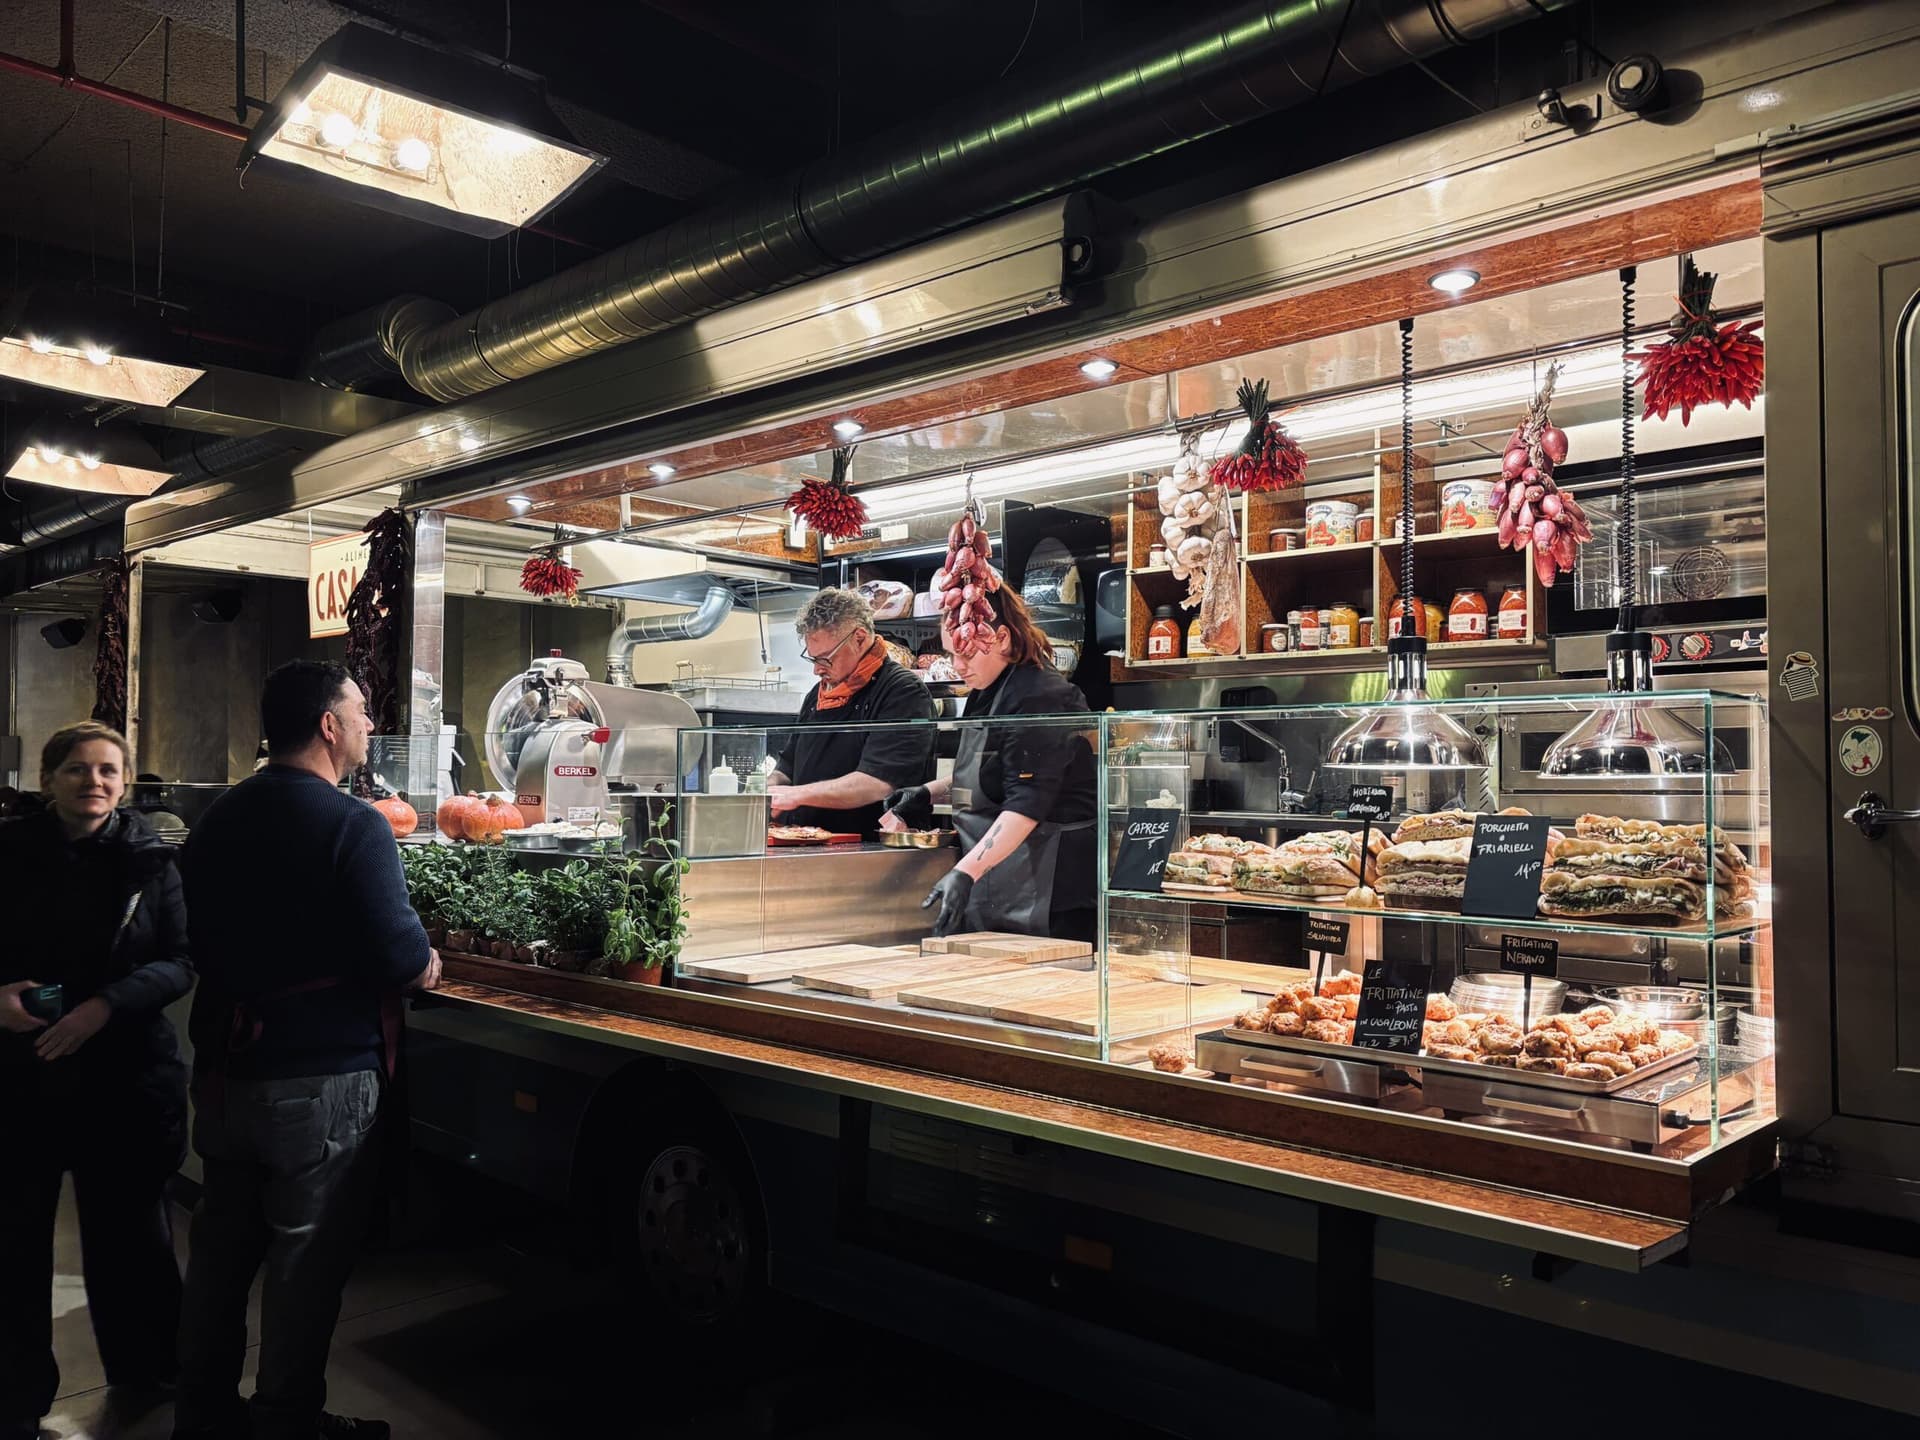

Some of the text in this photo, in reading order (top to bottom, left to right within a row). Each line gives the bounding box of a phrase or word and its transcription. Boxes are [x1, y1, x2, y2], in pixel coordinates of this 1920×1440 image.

[558, 767, 593, 776] BERKEL
[1127, 821, 1170, 836] CAPRESE
[1479, 822, 1530, 834] PORCHETTA
[1476, 843, 1534, 856] FRIARIELLI
[1506, 950, 1546, 965] NERANO
[1367, 967, 1382, 980] LE
[1365, 984, 1425, 1001] FRITTATINE
[1395, 1000, 1419, 1015] PASTA
[1388, 1018, 1419, 1031] LEONE
